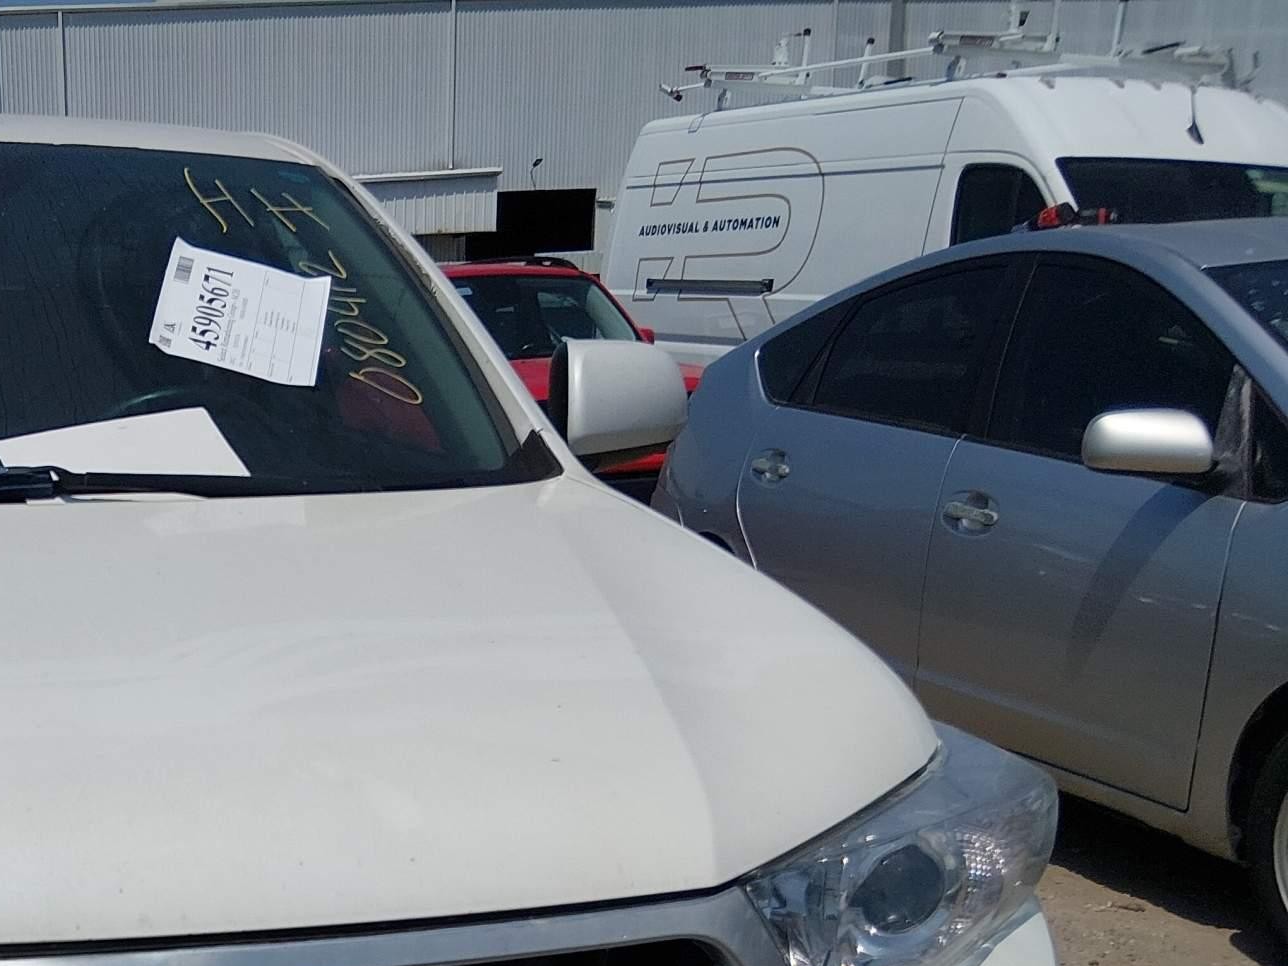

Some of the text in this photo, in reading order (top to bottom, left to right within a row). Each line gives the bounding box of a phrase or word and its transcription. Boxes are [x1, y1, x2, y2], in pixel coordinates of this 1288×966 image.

[639, 215, 782, 238] AUDIOVISUAL & AUTOMATION
[188, 266, 235, 353] 45905671
